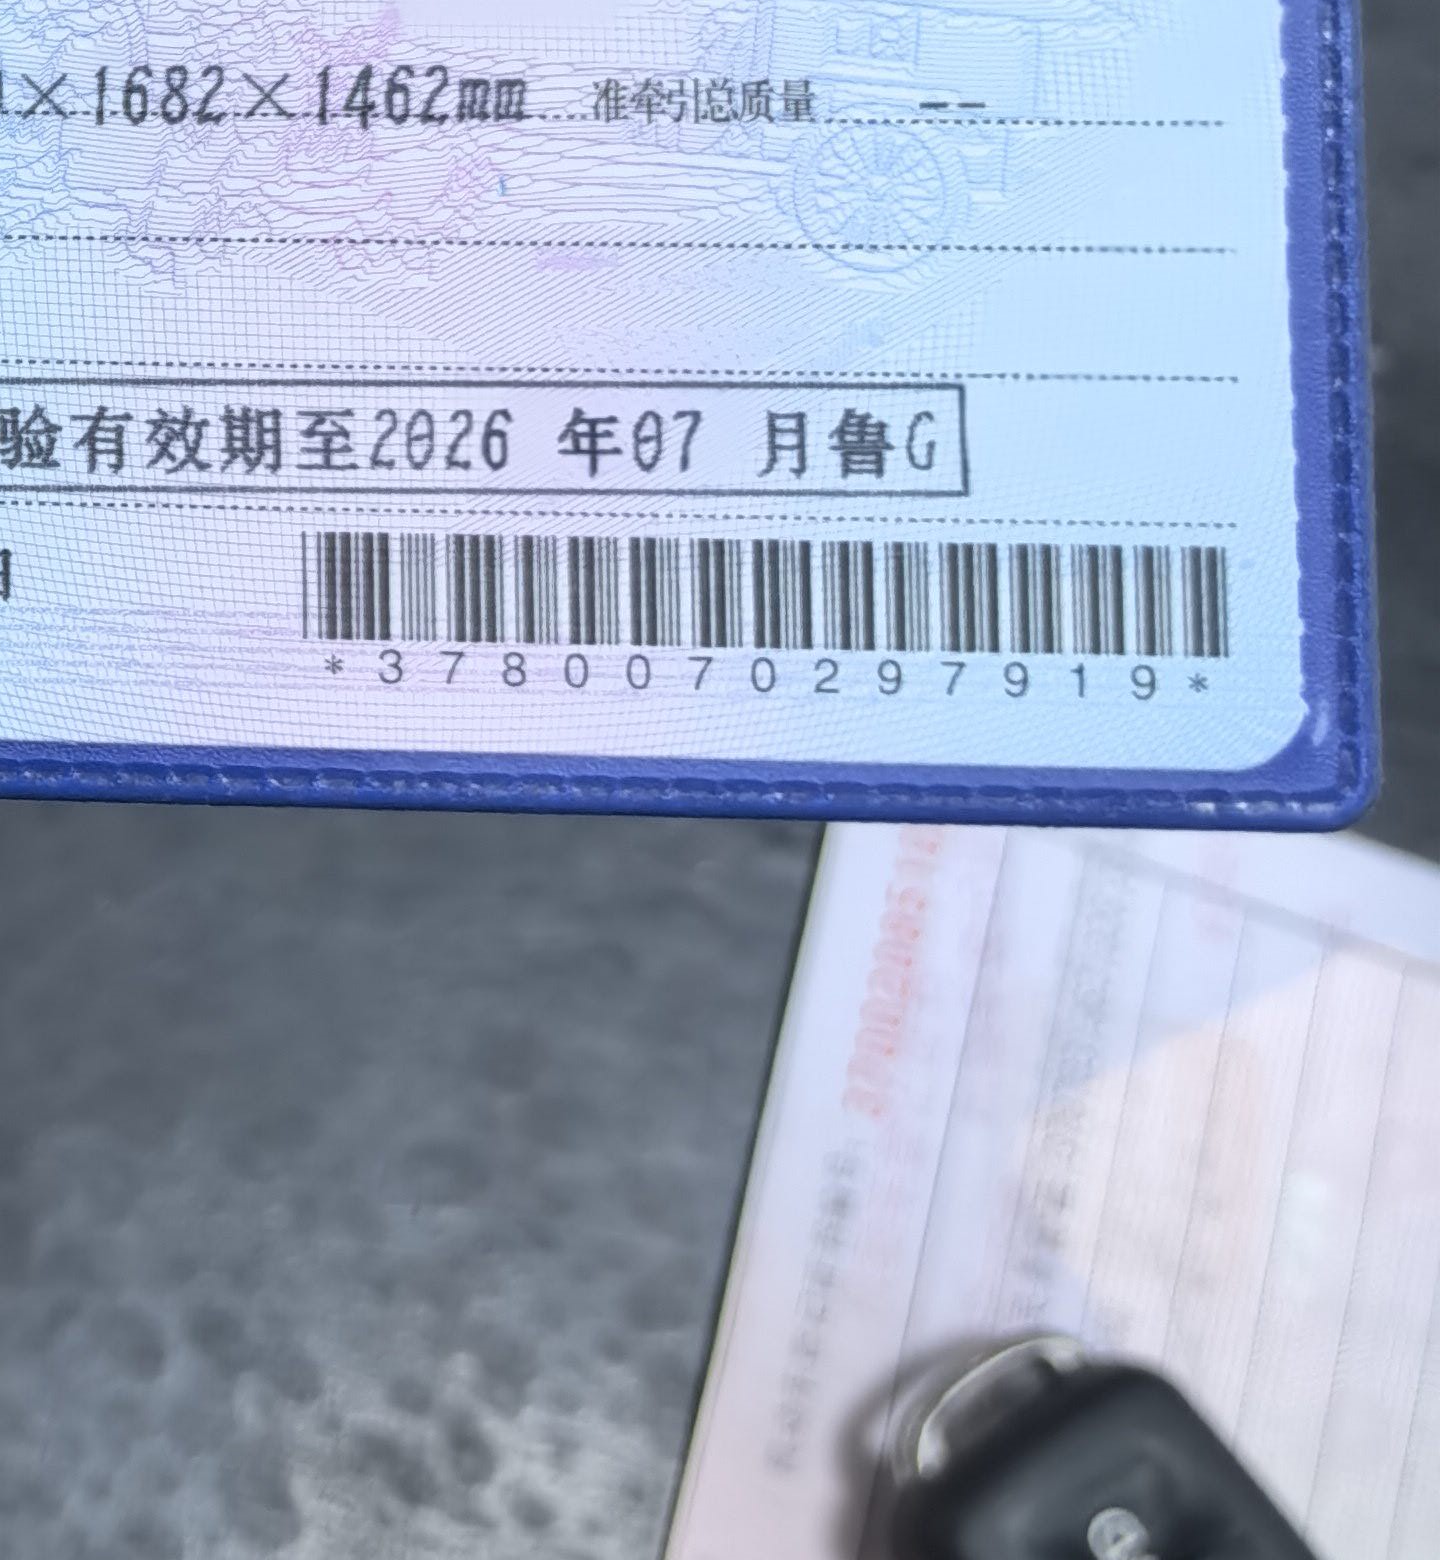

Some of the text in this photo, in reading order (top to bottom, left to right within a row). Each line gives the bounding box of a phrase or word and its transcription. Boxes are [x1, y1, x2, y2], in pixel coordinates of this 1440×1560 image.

[592, 76, 816, 124] 准牵引总质量
